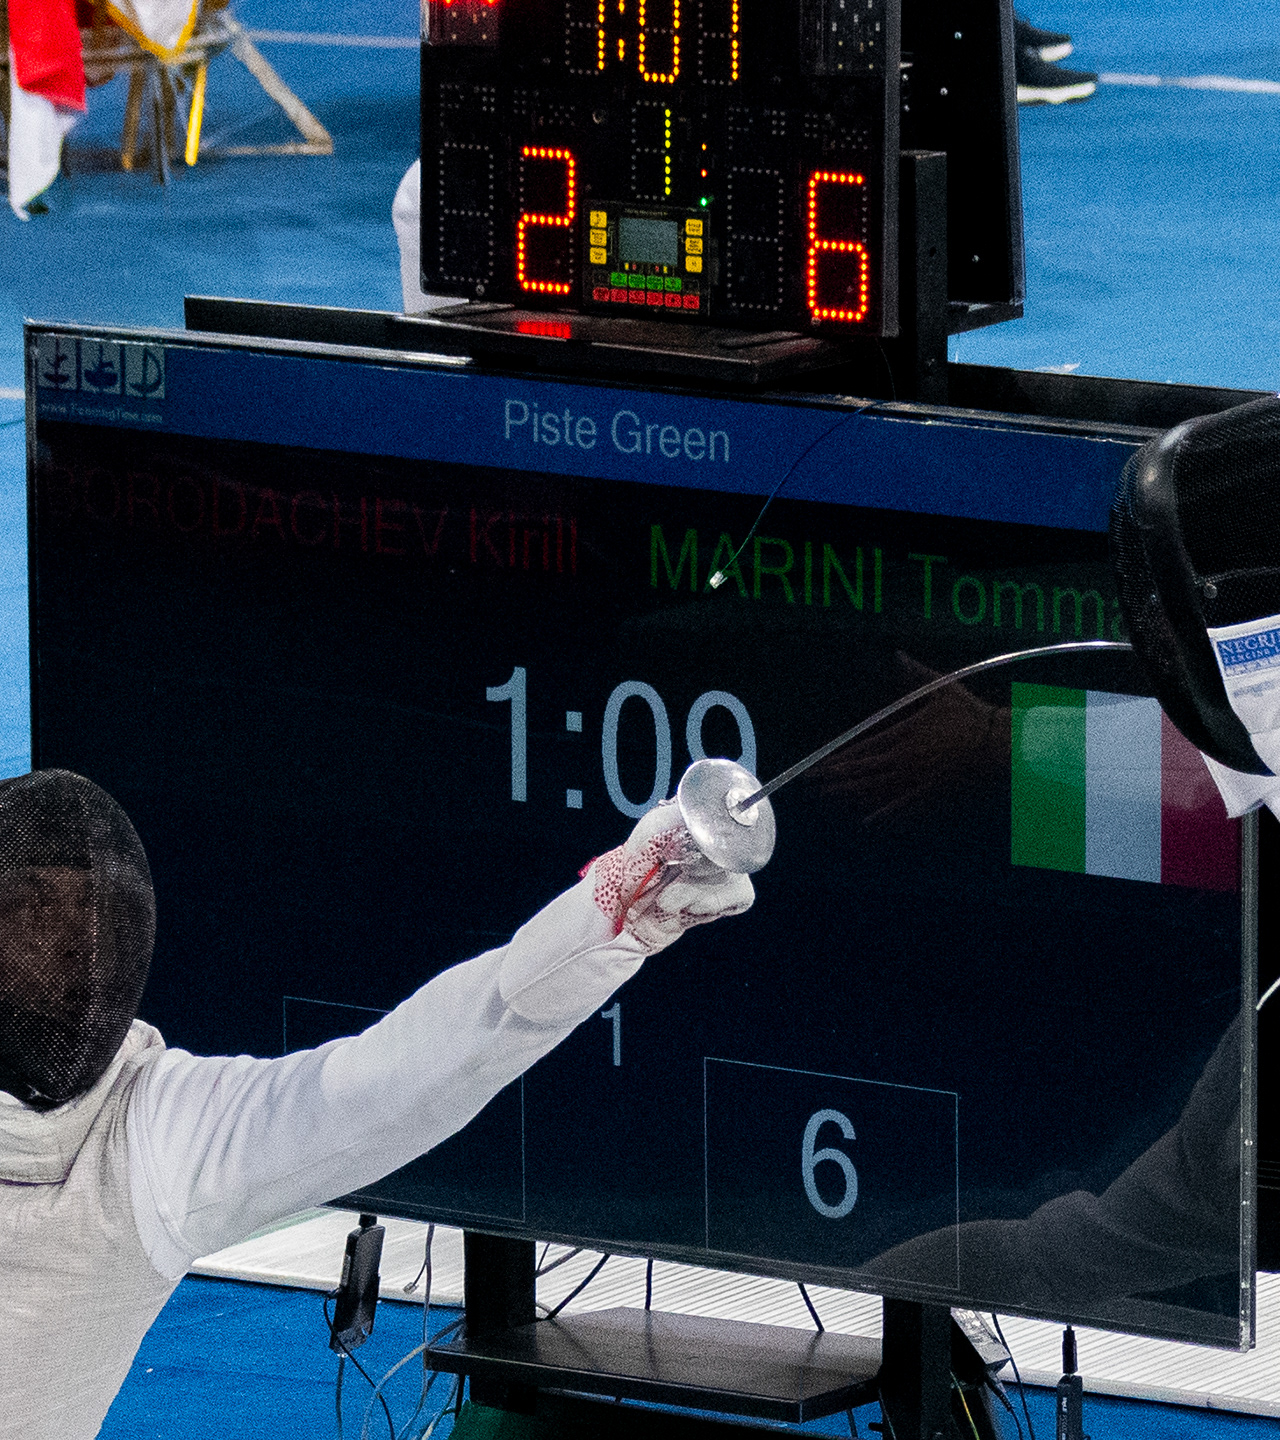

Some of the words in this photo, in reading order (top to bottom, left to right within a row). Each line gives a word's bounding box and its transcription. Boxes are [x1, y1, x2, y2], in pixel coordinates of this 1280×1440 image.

[518, 146, 575, 294] 2
[809, 170, 867, 320] 6
[505, 399, 597, 449] Piste
[610, 410, 730, 463] Green
[48, 466, 449, 557] BORODACHEV
[469, 505, 579, 576] Kirill
[650, 523, 883, 613] MARINI
[601, 1001, 623, 1067] 1
[801, 1109, 860, 1219] 6
